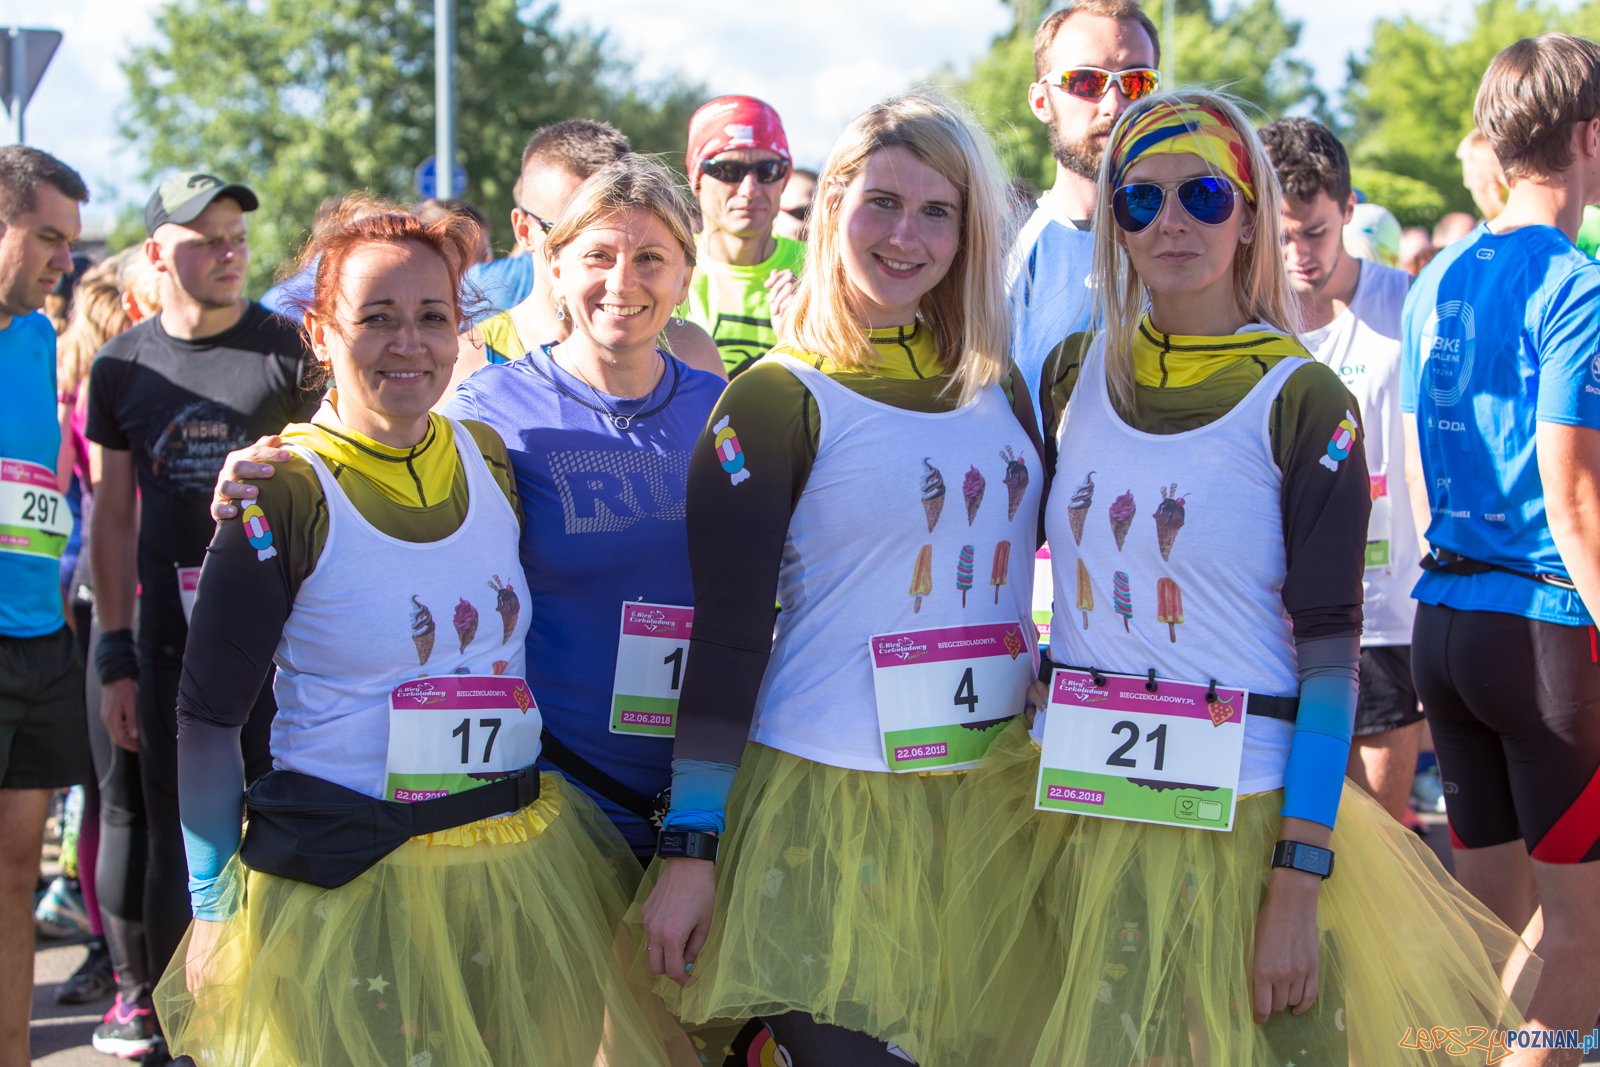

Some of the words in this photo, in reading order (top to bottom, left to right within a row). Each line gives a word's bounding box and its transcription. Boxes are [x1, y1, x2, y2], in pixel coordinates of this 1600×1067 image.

[21, 491, 58, 525] 297
[937, 638, 997, 649] BIEGCZEKOLADOWY.PL
[663, 647, 683, 690] 1
[954, 668, 978, 713] 4
[1067, 680, 1083, 688] Bieg
[456, 690, 508, 698] BIEGCZEKOLADOWY.PL
[1119, 691, 1196, 706] BIEGCZEKOLADOWY.PL
[623, 712, 671, 724] 22.06.2018
[453, 718, 502, 764] 17
[1106, 721, 1168, 771] 21
[897, 745, 946, 759] 22.06.2018
[1049, 787, 1102, 802] 22.06.2018
